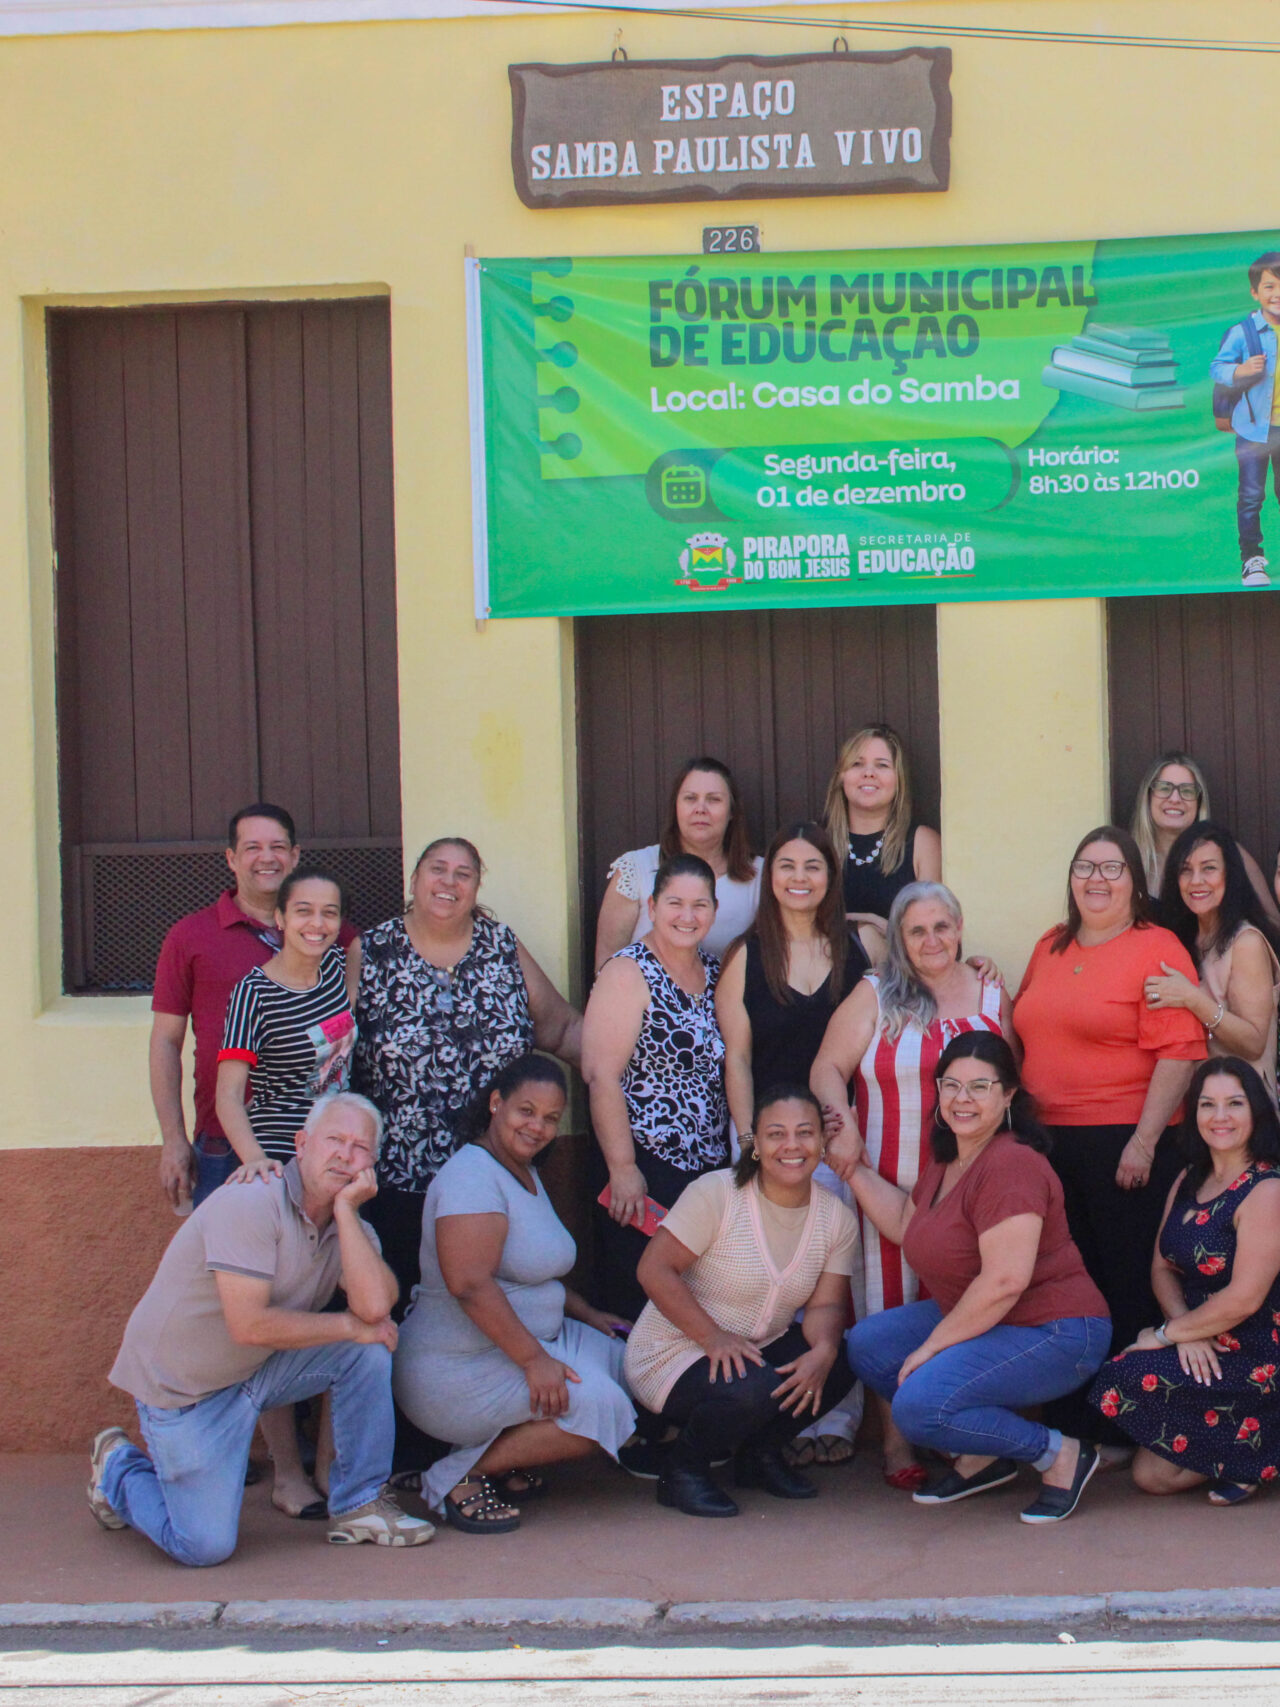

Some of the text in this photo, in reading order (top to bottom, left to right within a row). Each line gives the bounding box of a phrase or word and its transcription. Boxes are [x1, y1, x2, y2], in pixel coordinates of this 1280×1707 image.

[660, 80, 796, 122] ESPAÇO
[531, 127, 923, 180] SAMBA PAULISTA VIVO
[709, 228, 754, 253] 226
[649, 265, 1098, 323] FÓRUM MUNICIPAL
[650, 324, 709, 368] DE
[650, 374, 1020, 413] Local: Casa do Samba
[764, 447, 956, 480] Segunda-feira,
[1028, 445, 1120, 467] Horário:
[756, 480, 966, 508] 01 de dezembro
[1029, 469, 1199, 494] 8h30 às 12h00
[743, 534, 850, 559] PIRAPORA
[859, 532, 972, 546] SECRETARIA DE
[743, 557, 850, 580] DO BOM JESUS
[858, 542, 976, 576] EDUCAÇÃO
